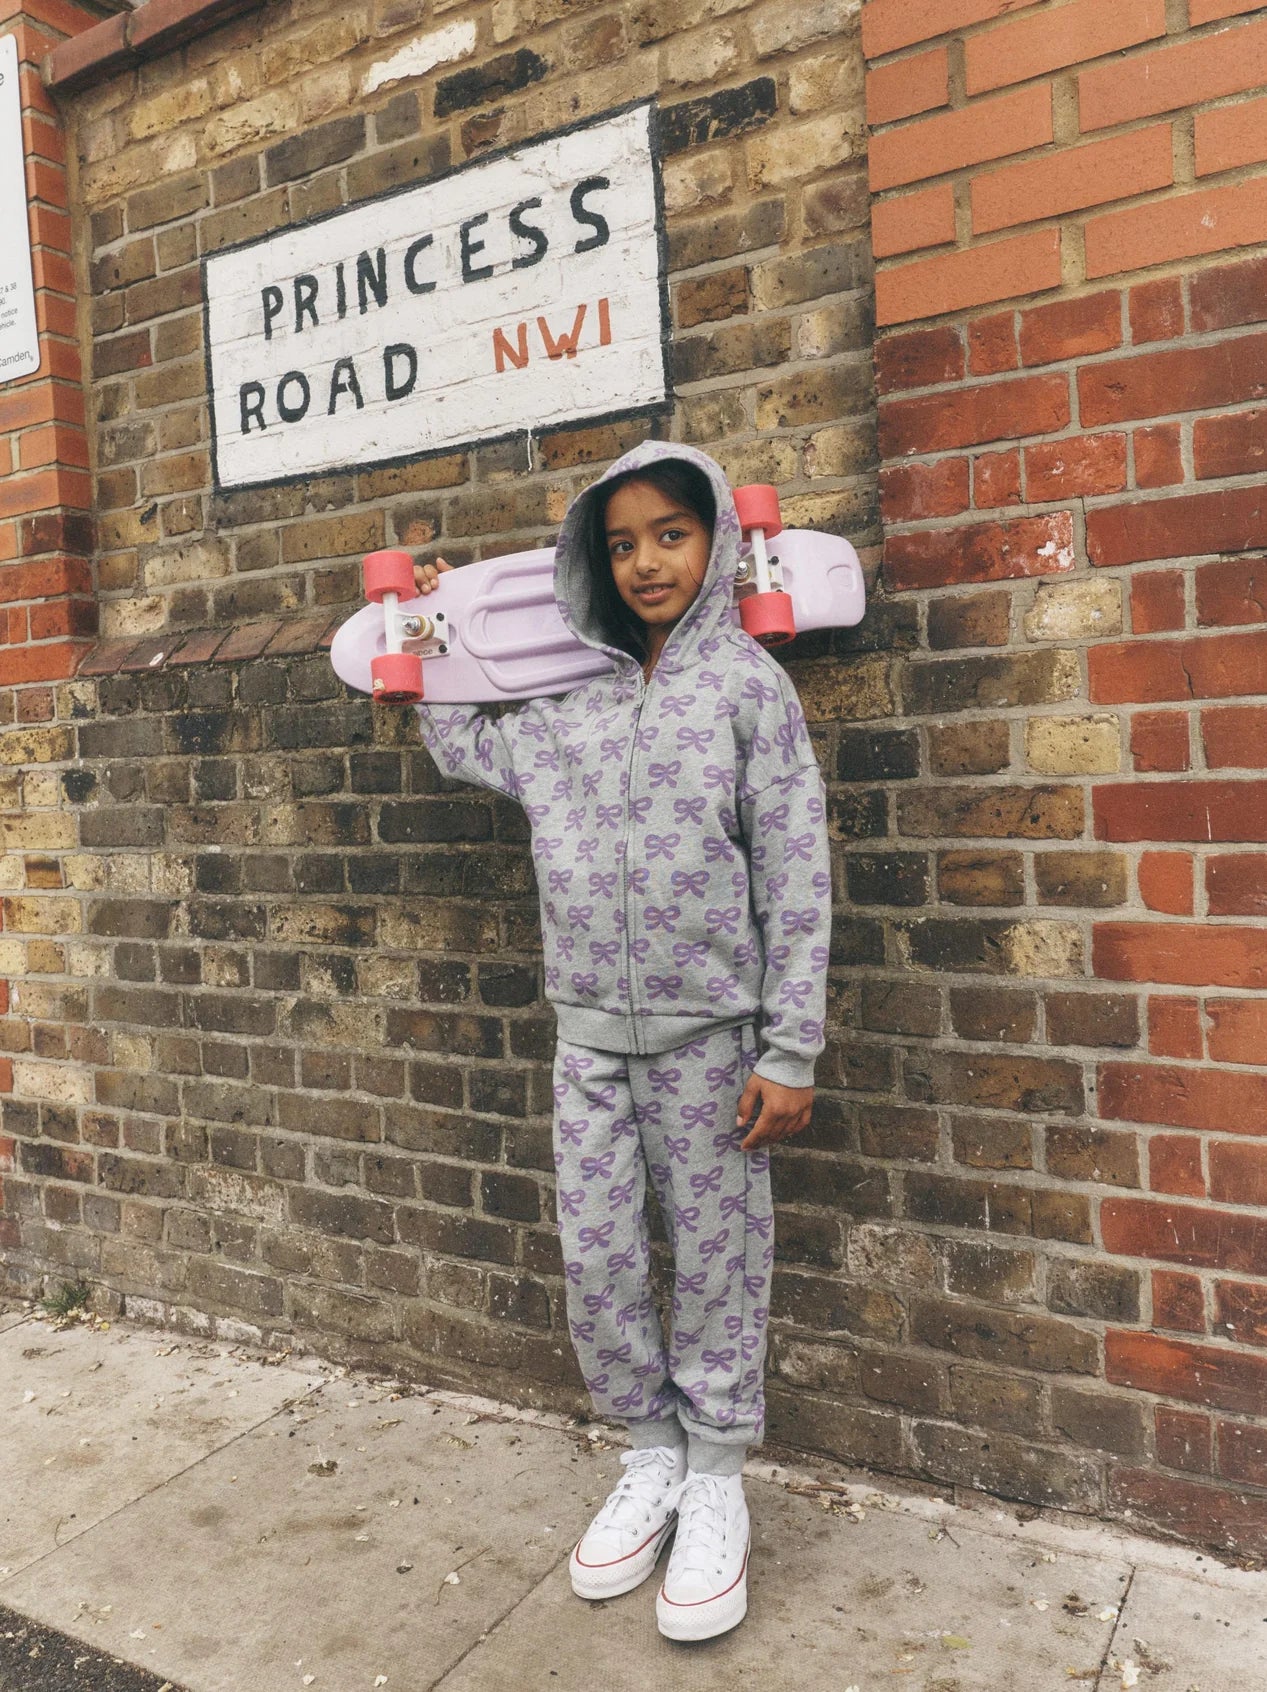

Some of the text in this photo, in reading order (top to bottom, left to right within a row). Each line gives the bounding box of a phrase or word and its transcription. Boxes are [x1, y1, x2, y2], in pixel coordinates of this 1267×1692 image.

[261, 176, 610, 340] PRINCESS
[0, 351, 31, 367] amden
[240, 343, 418, 434] ROAD
